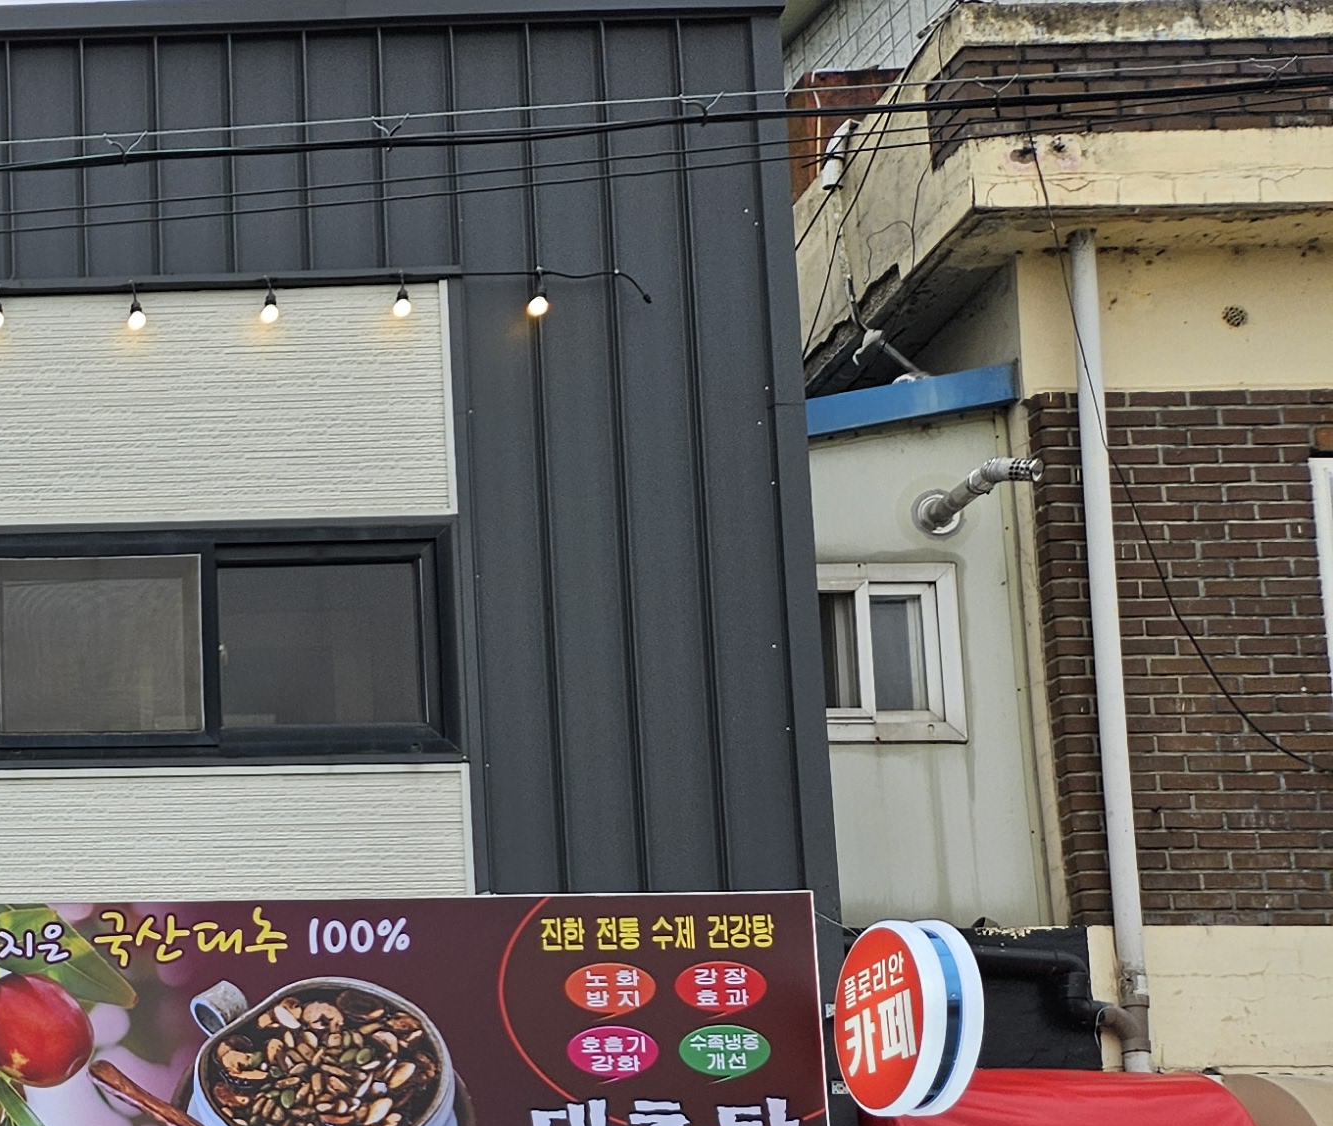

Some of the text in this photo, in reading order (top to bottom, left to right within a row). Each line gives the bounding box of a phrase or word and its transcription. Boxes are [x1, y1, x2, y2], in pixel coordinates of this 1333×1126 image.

[93, 907, 288, 968] 국산대추
[307, 917, 410, 956] 100%
[540, 915, 775, 953] 진한 전통 수제 건강탕
[585, 969, 640, 987] 노화
[694, 968, 748, 985] 강장
[845, 951, 904, 1009] 플로리안
[586, 990, 640, 1007] 방지
[696, 989, 749, 1006] 효과
[845, 989, 916, 1077] 카페
[581, 1036, 646, 1053] 호흡기
[690, 1034, 759, 1051] 수족냉증
[591, 1055, 641, 1072] 강화
[707, 1053, 747, 1070] 개선
